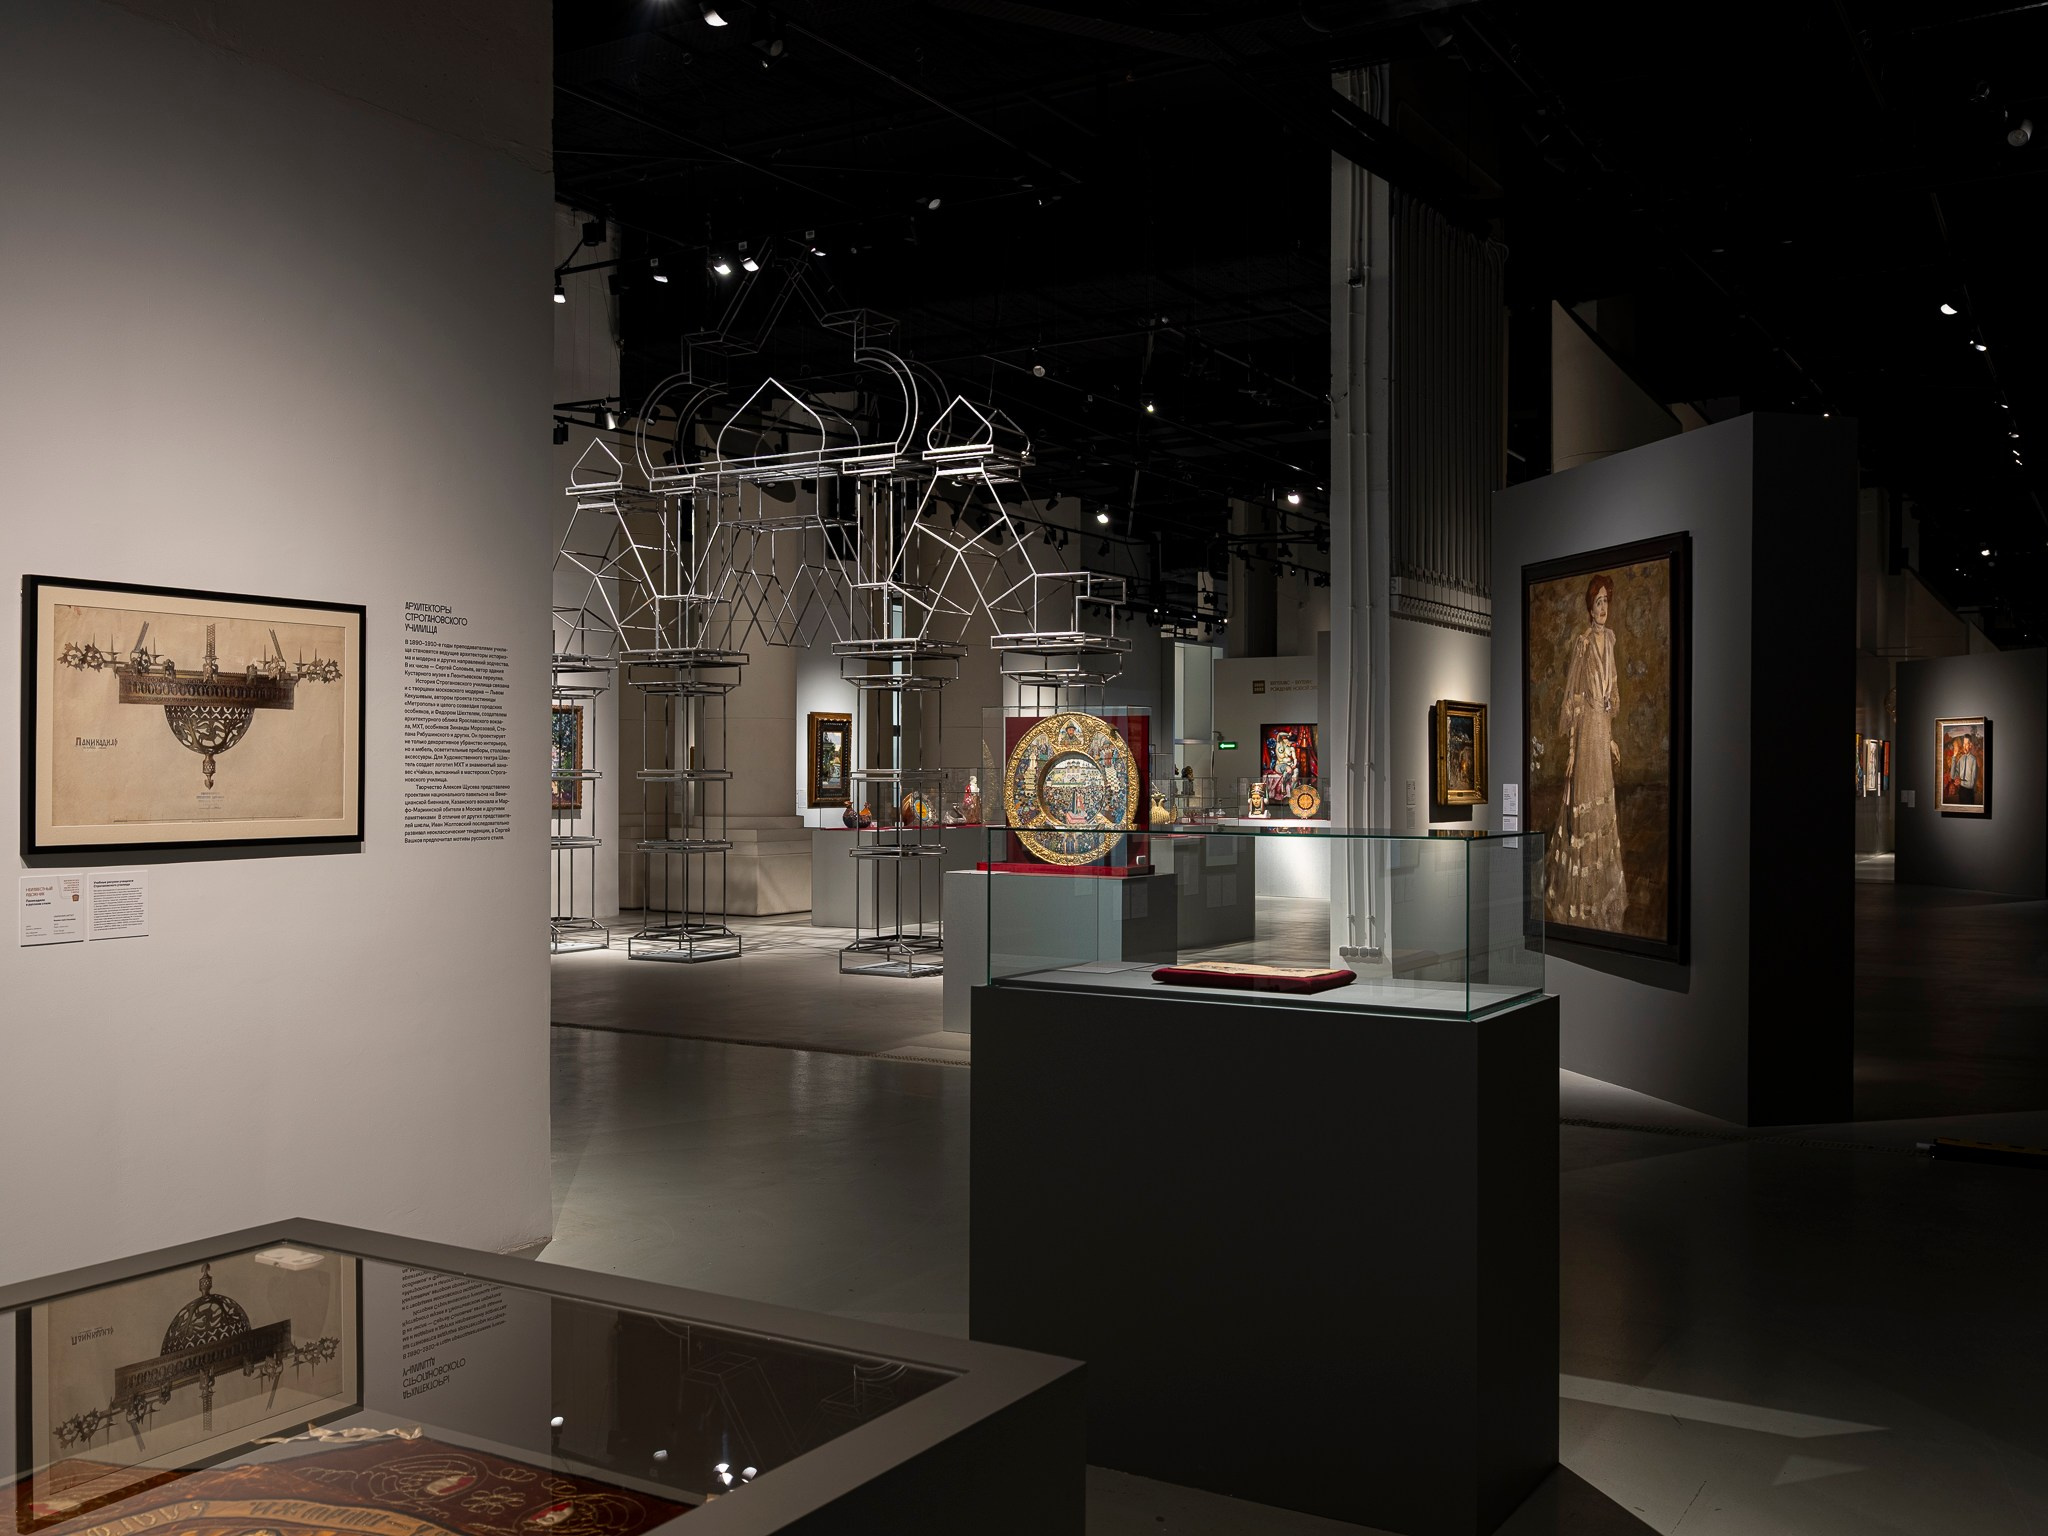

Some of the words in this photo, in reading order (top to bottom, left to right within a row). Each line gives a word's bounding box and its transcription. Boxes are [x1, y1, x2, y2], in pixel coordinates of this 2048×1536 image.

[405, 602, 452, 614] АРХИТЕКТОРЫ
[405, 613, 468, 626] СТРОГАНОВСКОГО
[405, 623, 437, 635] УЧИЛИЩА
